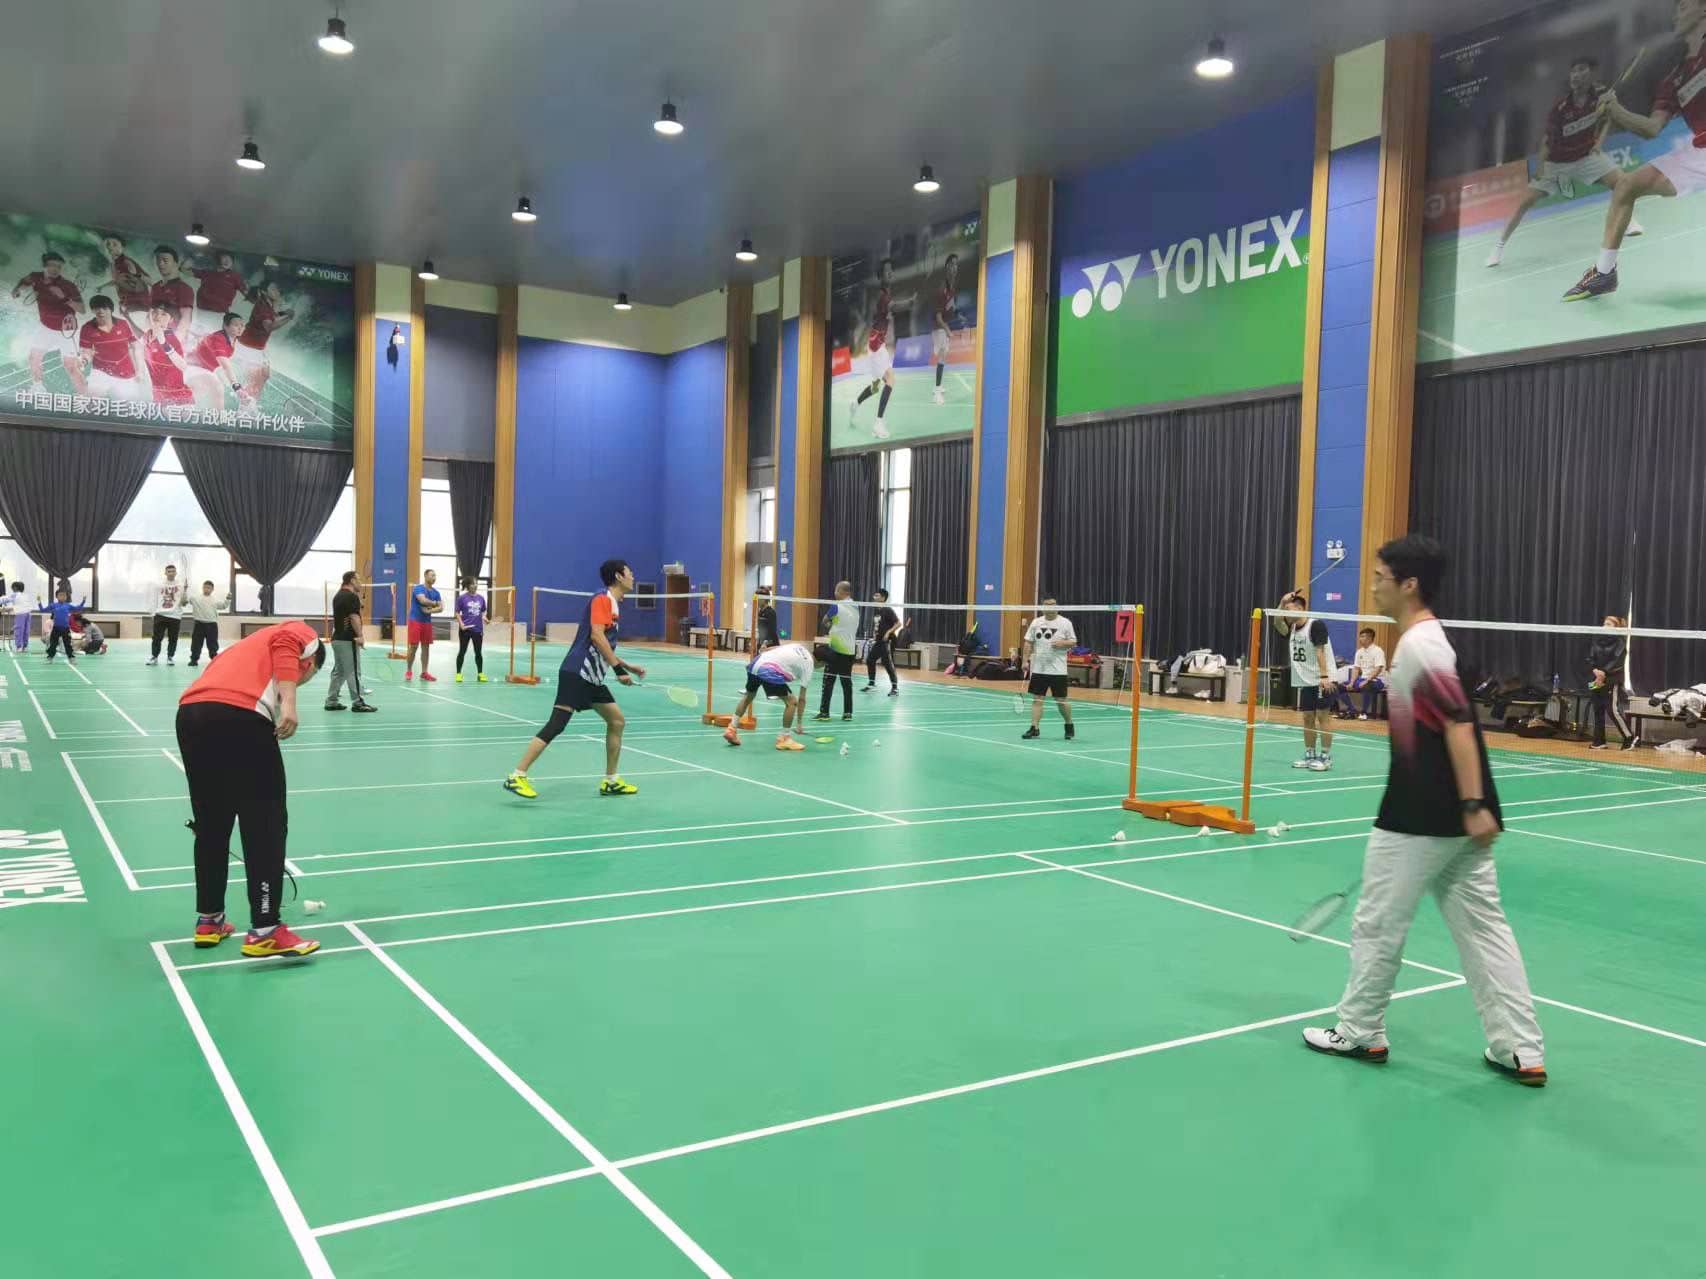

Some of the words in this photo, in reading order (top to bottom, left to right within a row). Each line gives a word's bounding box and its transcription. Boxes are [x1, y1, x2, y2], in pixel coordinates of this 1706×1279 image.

[1150, 208, 1304, 299] YONEX
[318, 269, 349, 281] YONEX
[15, 389, 306, 434] 中国国家羽毛球队官方战略合作伙伴
[1119, 615, 1130, 638] 7
[261, 893, 270, 914] YONEX
